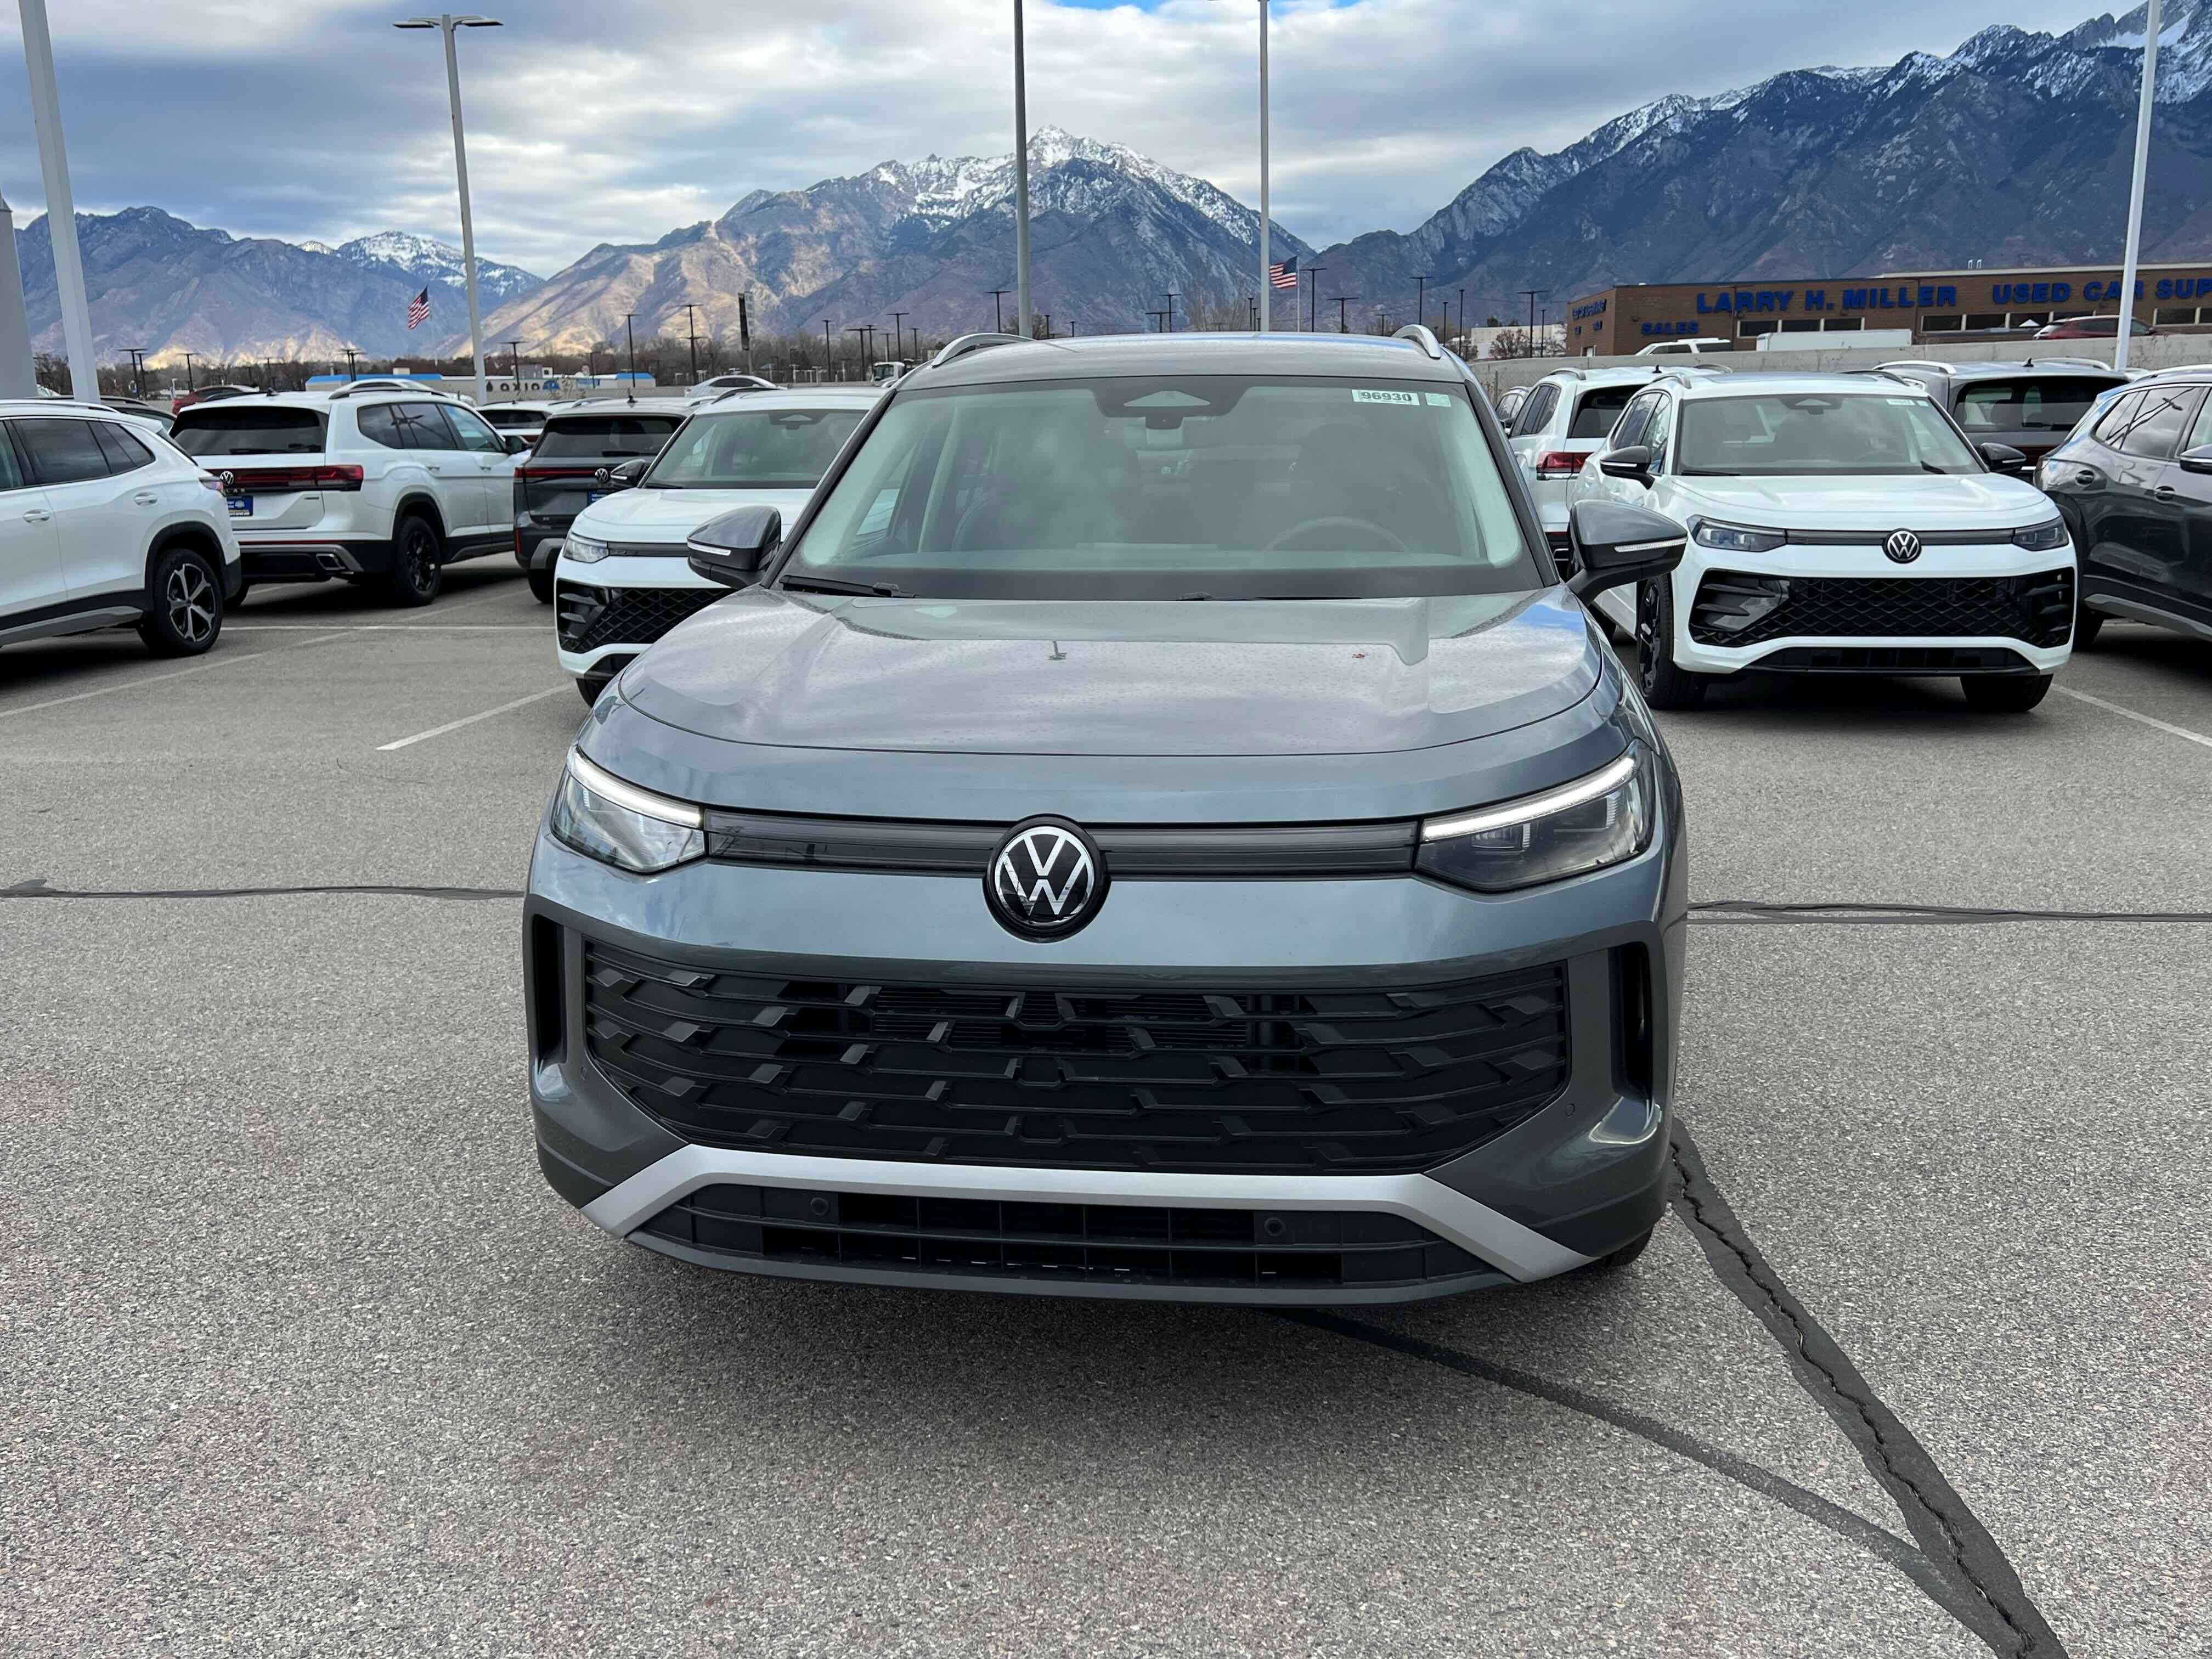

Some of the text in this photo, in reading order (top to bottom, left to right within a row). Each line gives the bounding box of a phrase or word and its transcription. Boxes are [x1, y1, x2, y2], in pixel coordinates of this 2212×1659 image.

[1697, 290, 1794, 313] LARRY
[1805, 289, 1835, 311] H.
[1843, 286, 1957, 309] MILLER
[1993, 283, 2072, 304] USED
[2155, 278, 2212, 300] SUP
[1641, 320, 1699, 335] SALES
[1361, 392, 1412, 401] 96930
[1887, 531, 1919, 561] VW
[995, 826, 1094, 926] VW
